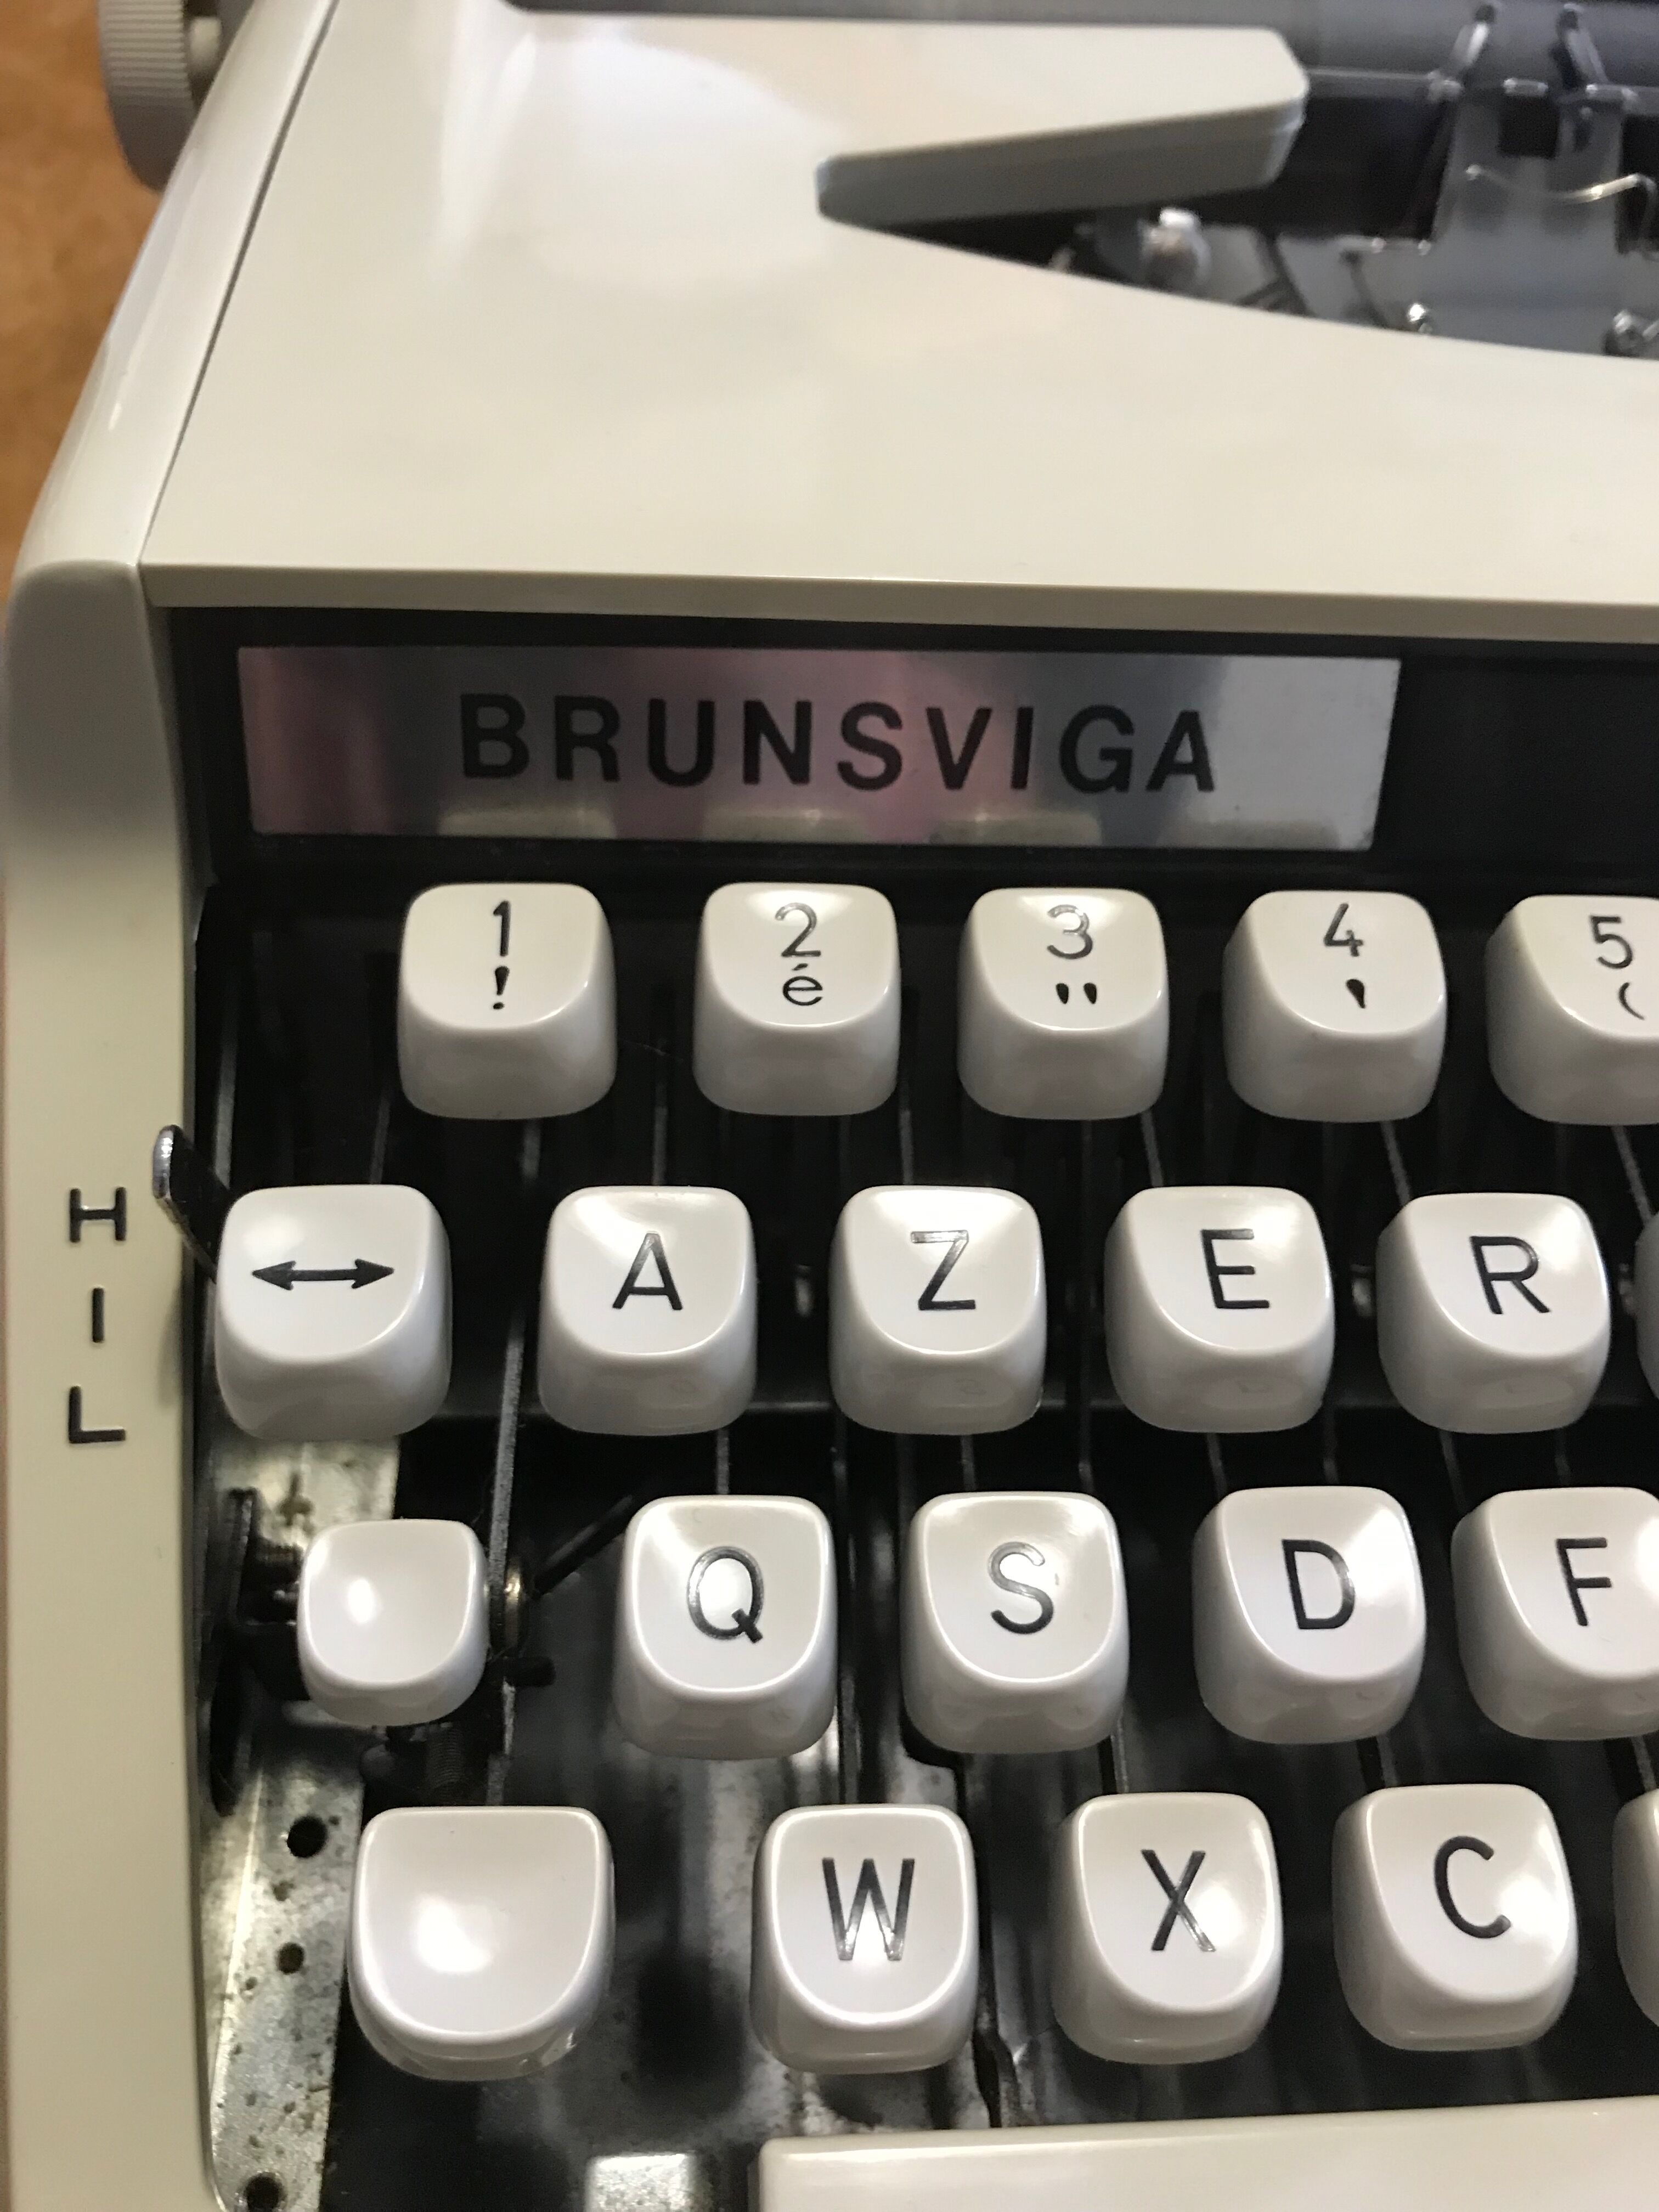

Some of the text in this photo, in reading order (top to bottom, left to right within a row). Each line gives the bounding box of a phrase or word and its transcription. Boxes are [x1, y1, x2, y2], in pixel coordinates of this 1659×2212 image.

[459, 693, 1216, 795] BRUNSVIGA
[493, 900, 511, 957] 1
[775, 902, 822, 958] 2
[1046, 904, 1093, 960] 3
[1323, 904, 1364, 957] 4
[1590, 915, 1633, 969] 5
[493, 966, 510, 1010] !
[782, 963, 823, 1006] é
[68, 1187, 127, 1244] H
[612, 1231, 683, 1311] A
[910, 1229, 977, 1311] Z
[1200, 1229, 1270, 1310] E
[1469, 1235, 1550, 1315] R
[67, 1386, 126, 1444] L
[689, 1547, 764, 1644] Q
[989, 1542, 1054, 1634] S
[1281, 1539, 1355, 1630] D
[1555, 1537, 1612, 1627] F
[822, 1858, 916, 1961] W
[1141, 1849, 1216, 1952] X
[1434, 1836, 1510, 1939] C
